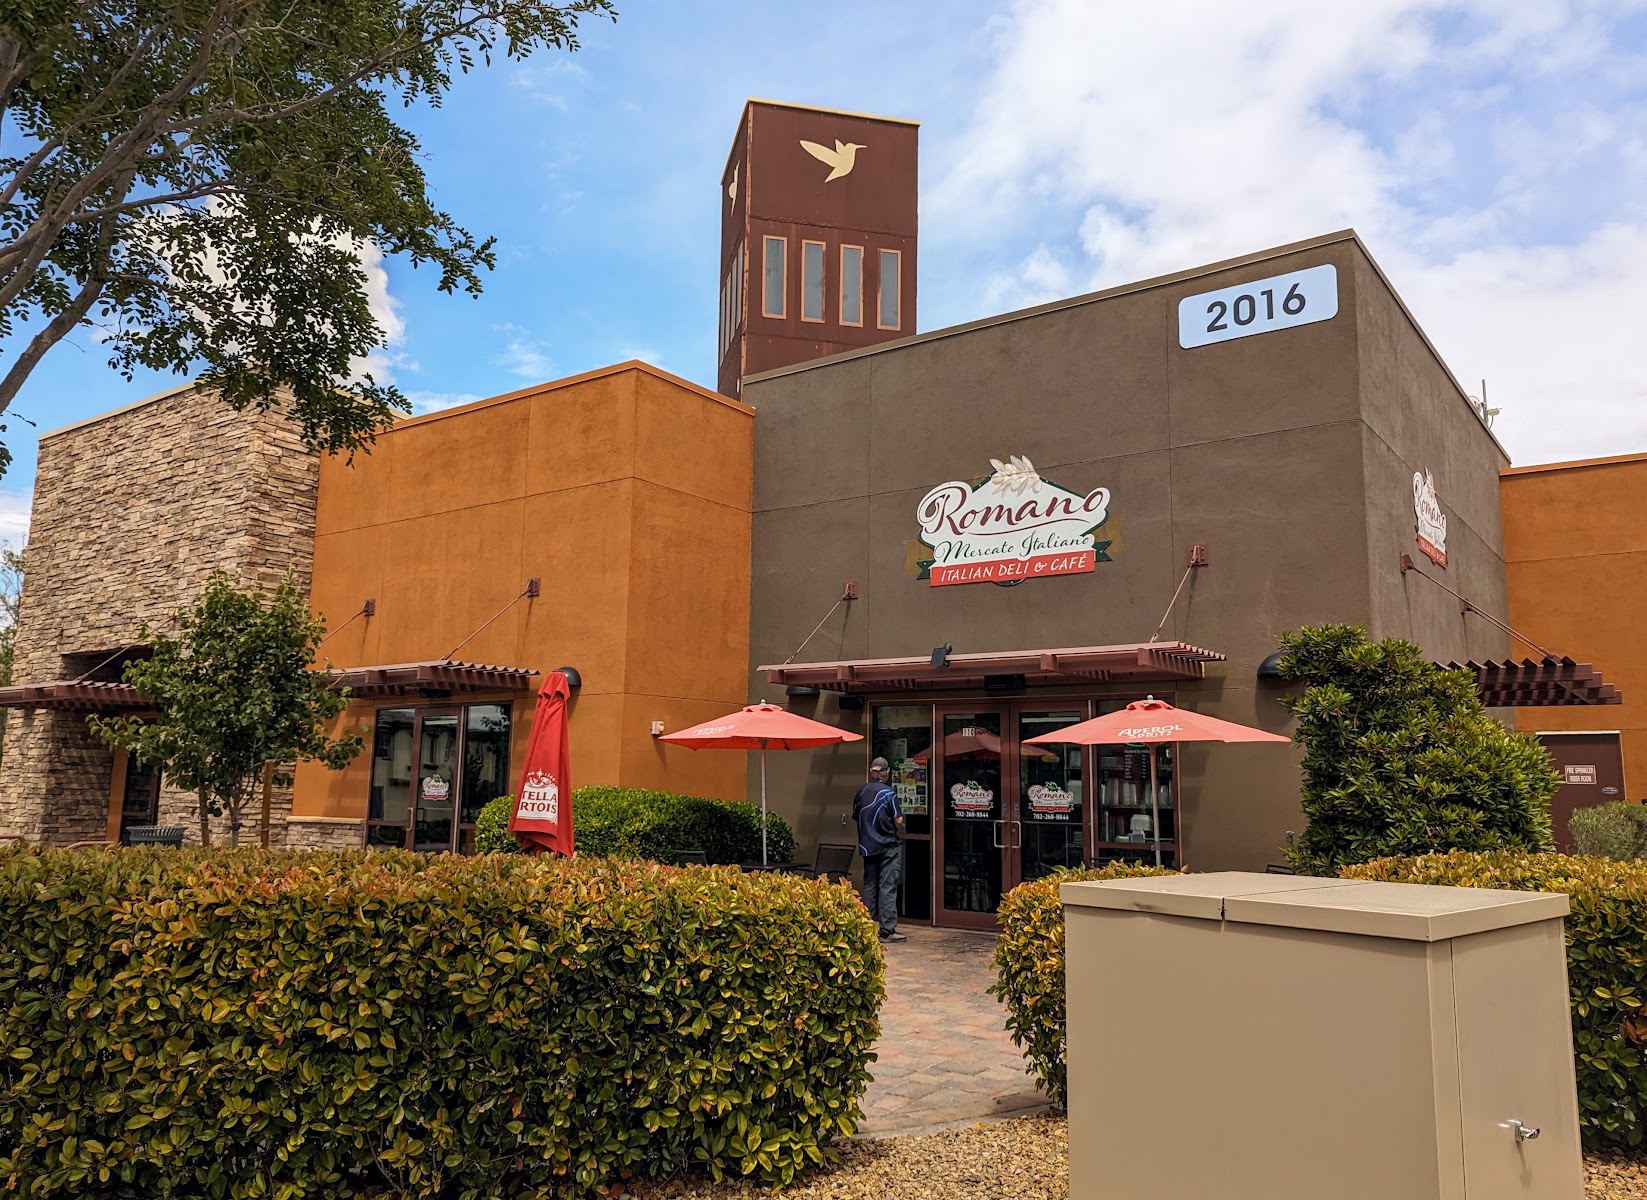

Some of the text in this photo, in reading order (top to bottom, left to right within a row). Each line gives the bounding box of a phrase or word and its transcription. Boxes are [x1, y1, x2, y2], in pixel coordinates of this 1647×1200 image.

[1206, 282, 1306, 333] 2016
[918, 486, 1104, 535] Romano
[935, 530, 1090, 563] Mercato Italiano
[941, 553, 1087, 582] ITALIAN DELI & CAFÉ
[1117, 724, 1184, 736] APEROL
[520, 801, 557, 814] RTOIS
[521, 791, 557, 803] TELLA
